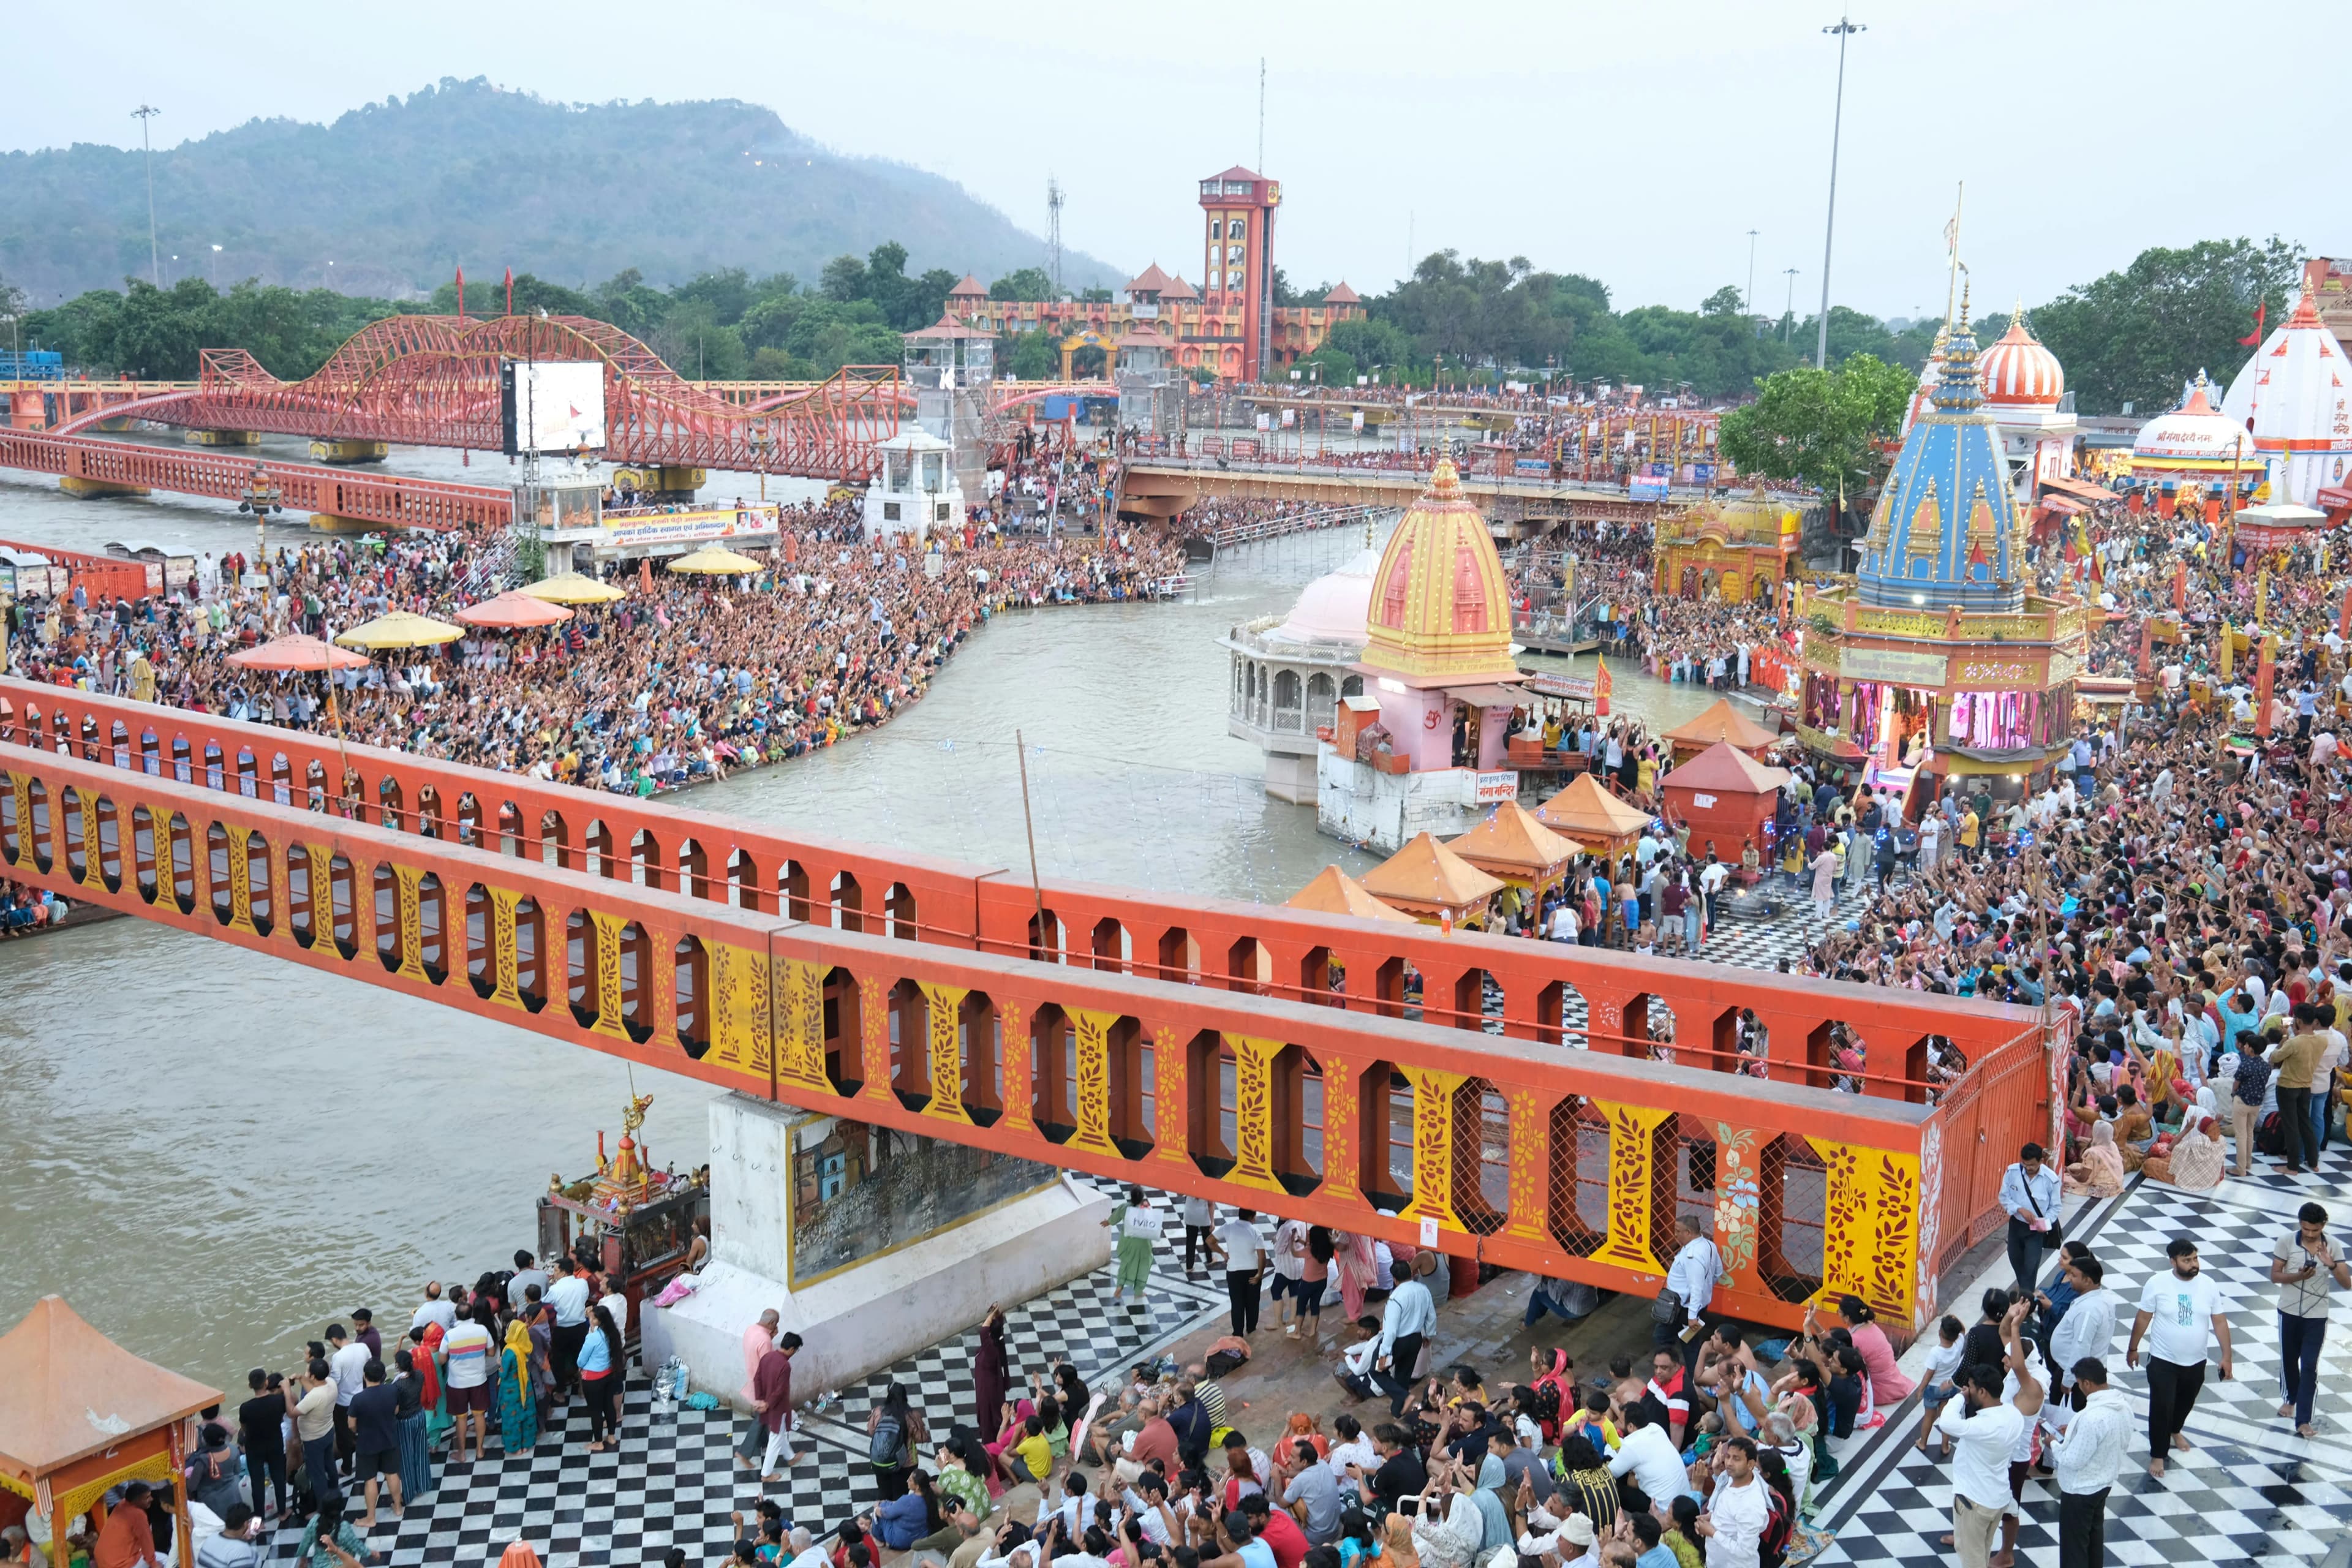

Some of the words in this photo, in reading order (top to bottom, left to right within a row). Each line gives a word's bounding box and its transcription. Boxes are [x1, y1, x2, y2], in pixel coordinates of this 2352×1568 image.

[2156, 432, 2166, 442] श्री
[2166, 433, 2180, 442] गंगा
[637, 526, 658, 535] हार्दिक
[1479, 785, 1493, 797] गंगा
[1494, 783, 1515, 797] मन्दिर
